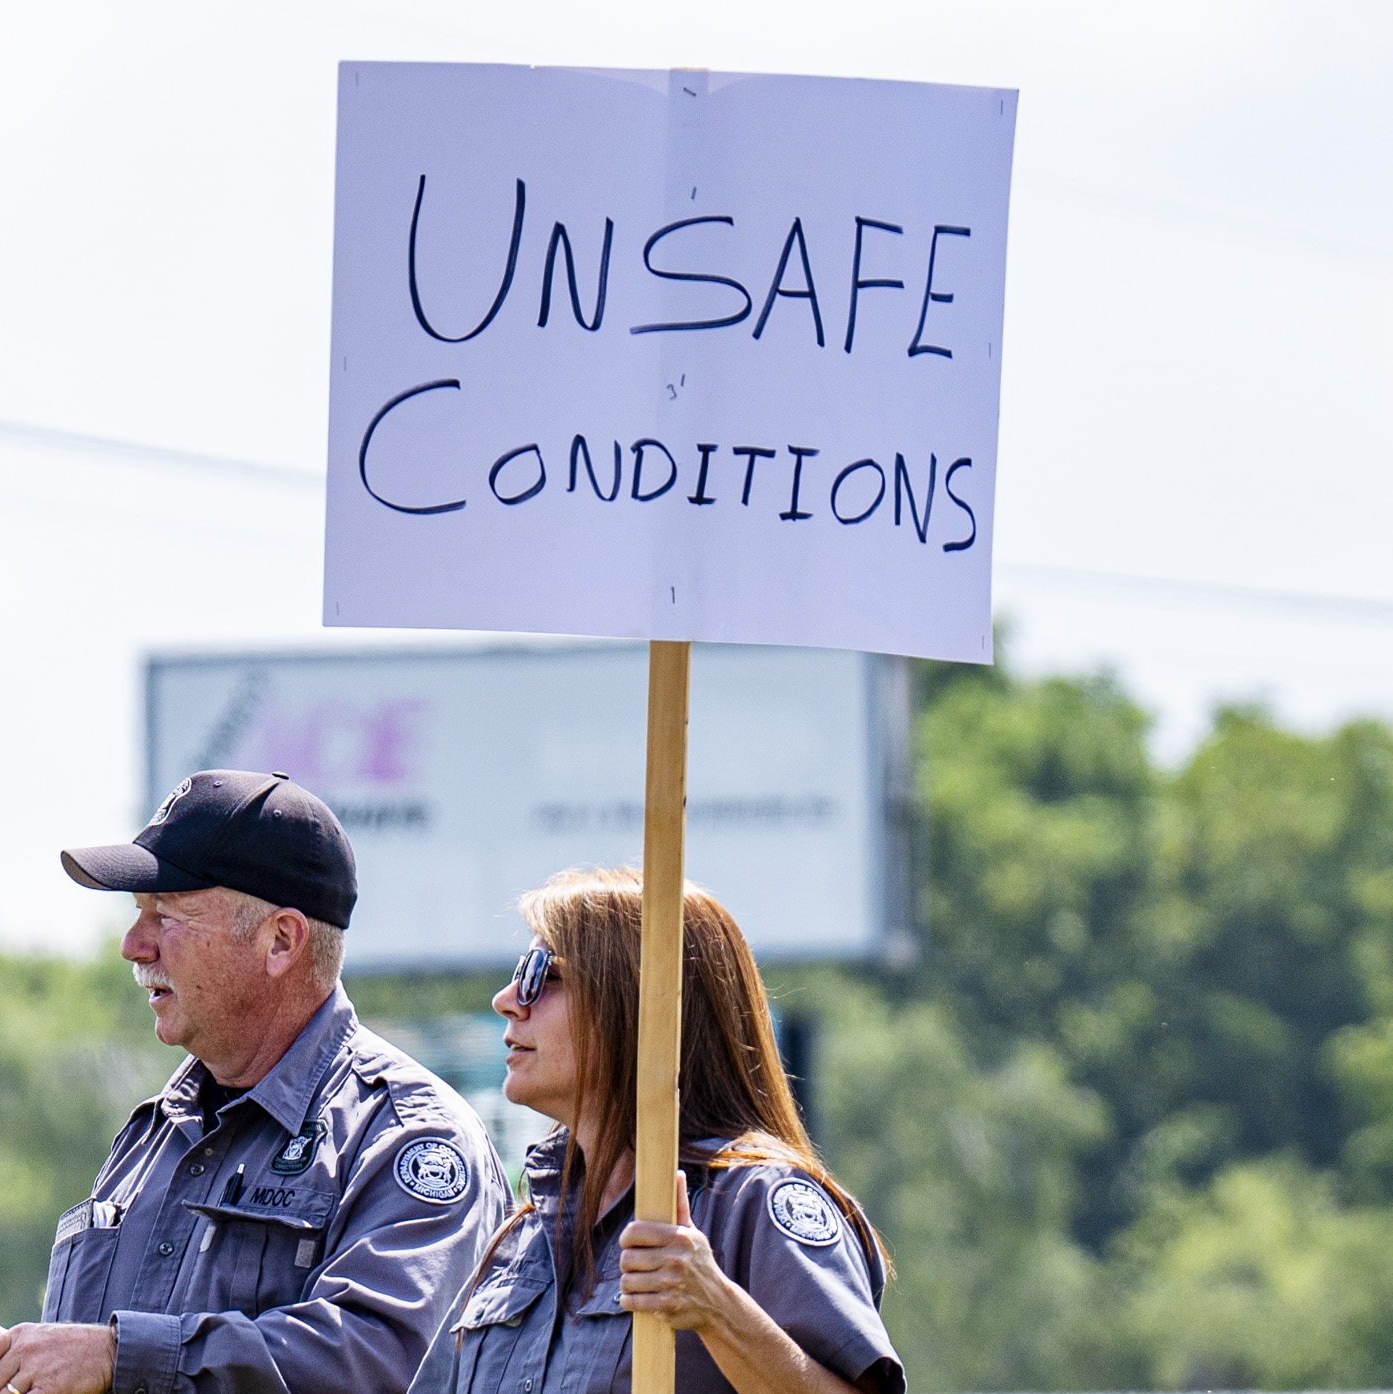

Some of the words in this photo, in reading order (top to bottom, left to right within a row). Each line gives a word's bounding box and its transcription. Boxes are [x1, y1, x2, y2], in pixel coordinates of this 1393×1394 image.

[408, 173, 972, 359] UNSAFE
[359, 378, 977, 552] CONDITIONS
[425, 1142, 438, 1150] OF
[249, 1187, 295, 1207] MDOC
[412, 1183, 456, 1199] MICHIGAN
